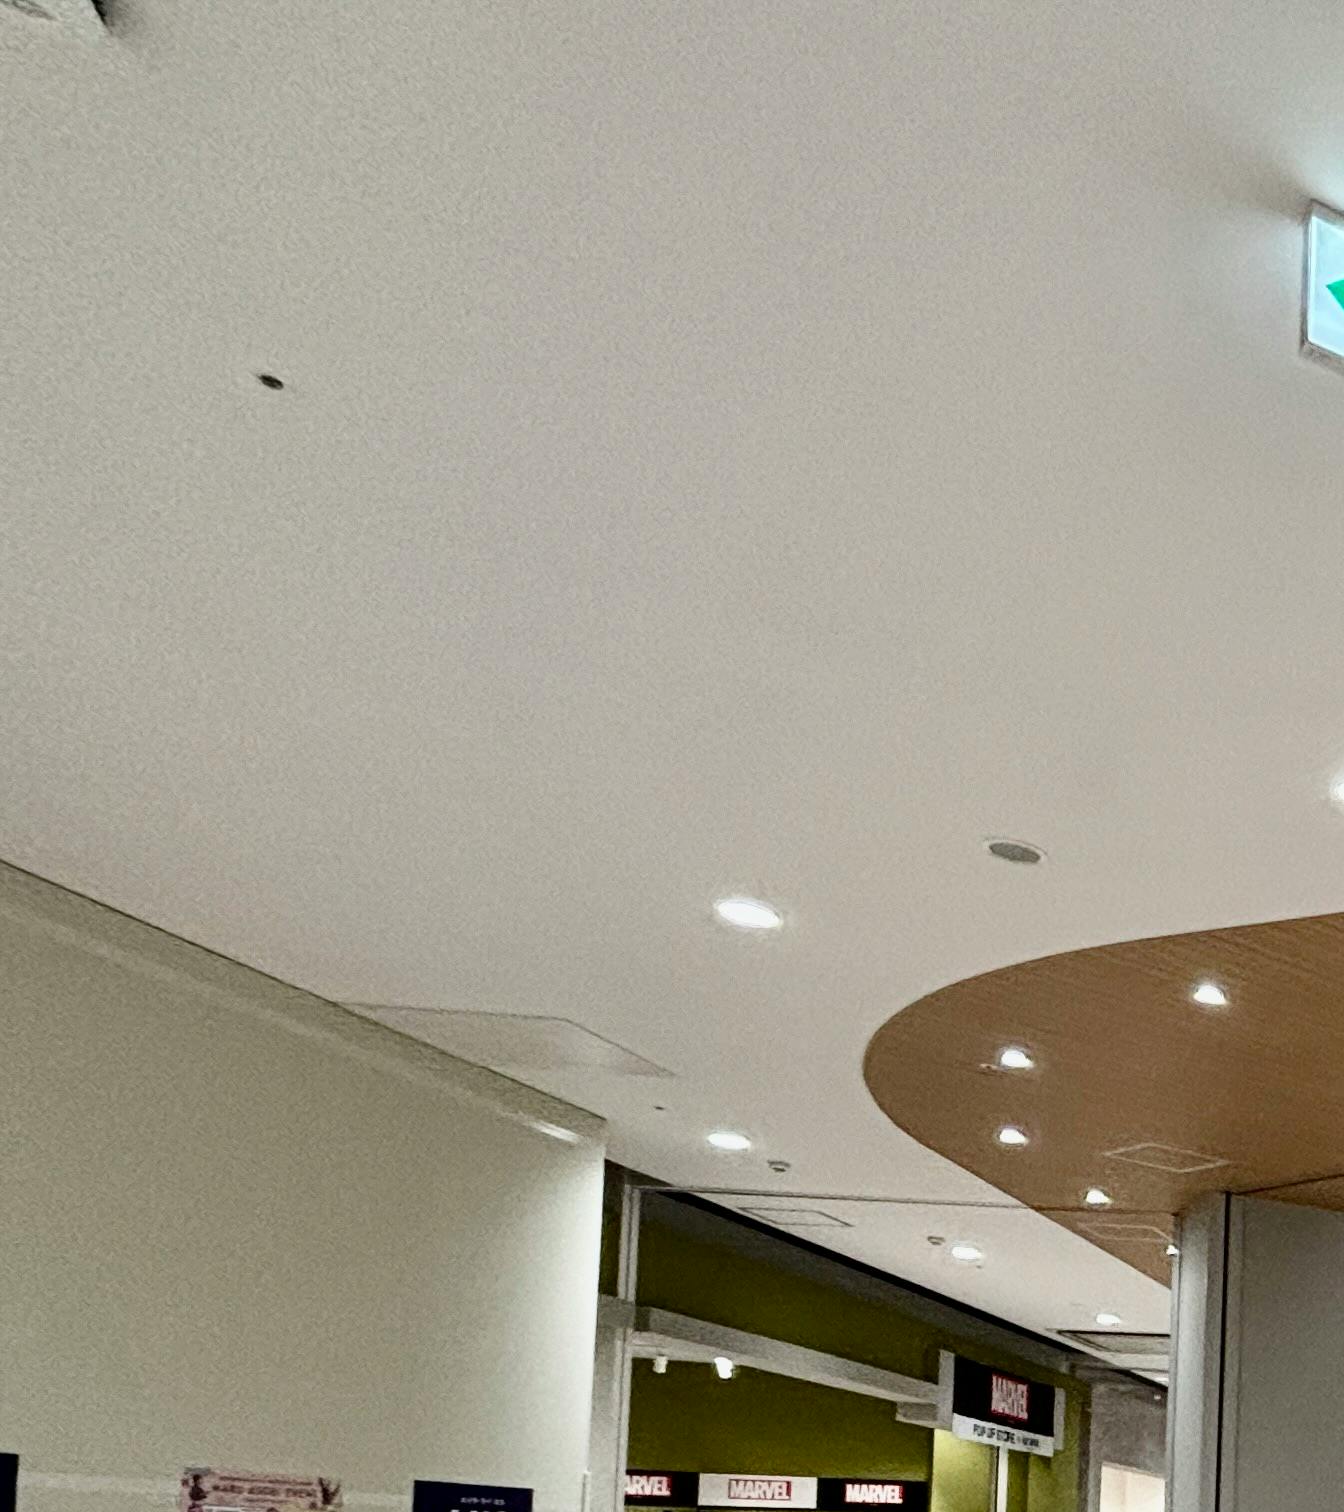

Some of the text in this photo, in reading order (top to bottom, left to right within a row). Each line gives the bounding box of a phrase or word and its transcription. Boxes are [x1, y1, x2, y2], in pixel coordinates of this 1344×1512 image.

[991, 1374, 1028, 1420] MARVEL
[625, 1475, 672, 1496] ARVEL
[728, 1479, 792, 1500] MARVEL
[845, 1483, 903, 1504] MARVEL
